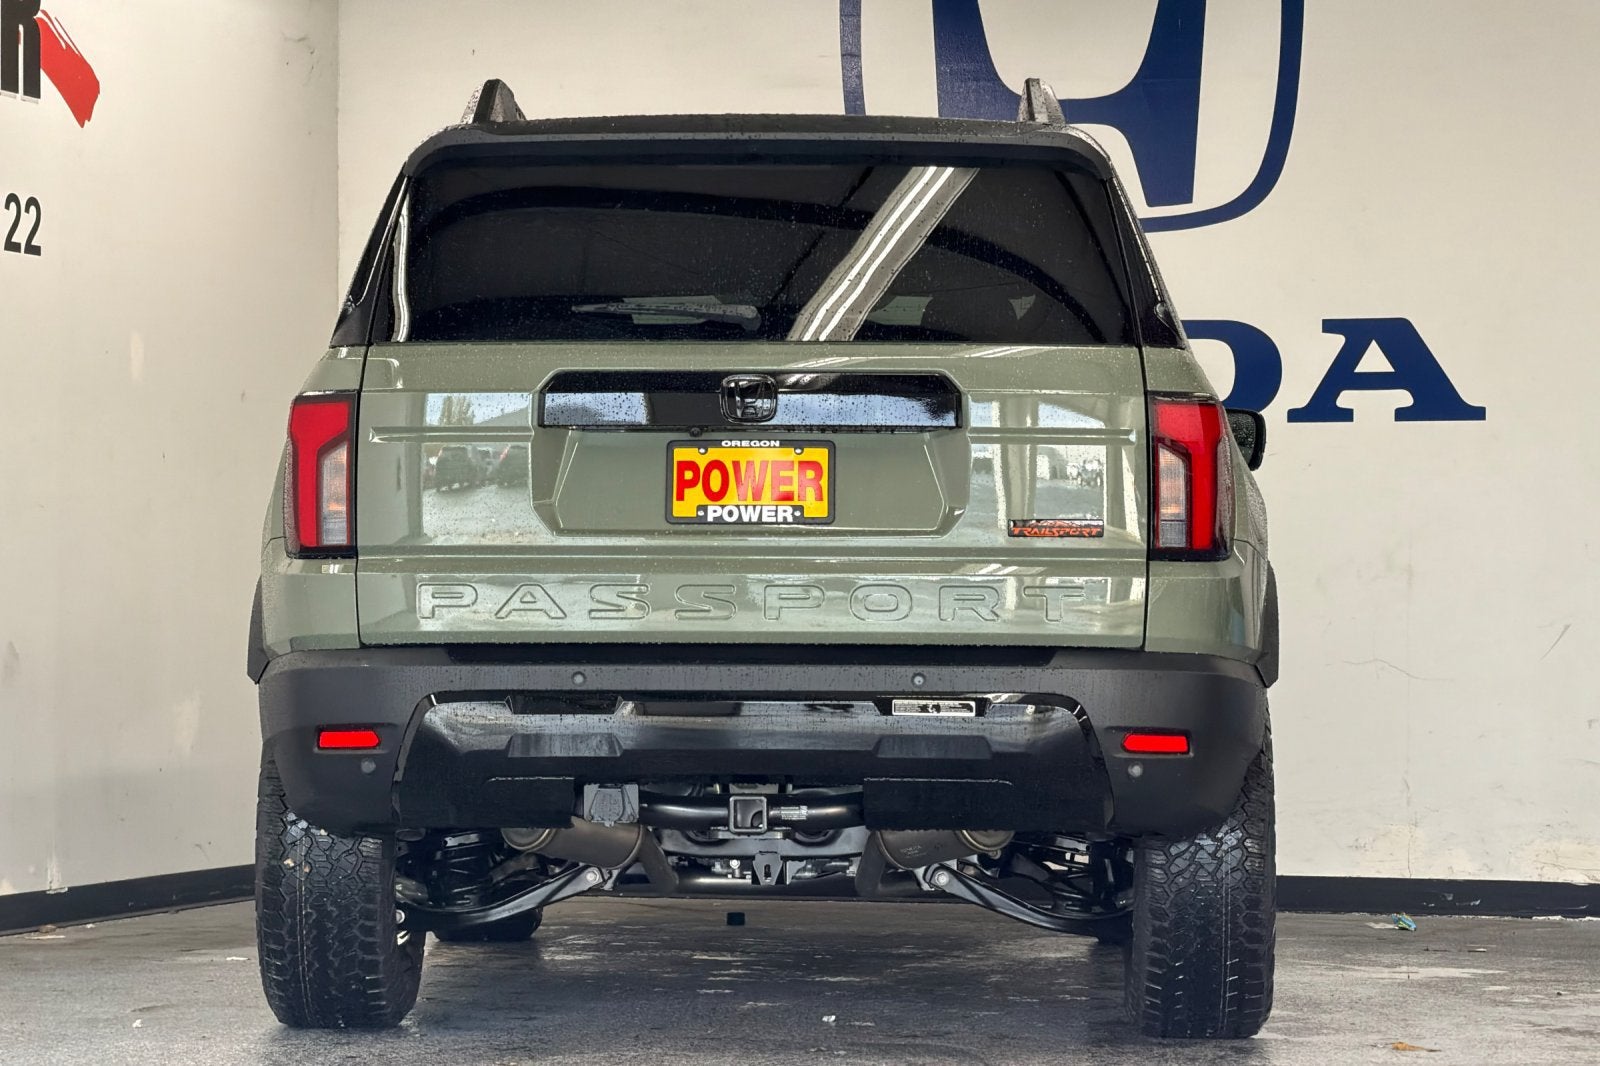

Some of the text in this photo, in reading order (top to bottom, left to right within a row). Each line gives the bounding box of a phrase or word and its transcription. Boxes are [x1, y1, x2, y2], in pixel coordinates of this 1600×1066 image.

[676, 459, 824, 502] POWER
[707, 505, 793, 522] POWER
[1011, 527, 1101, 537] TRAILSPORT
[417, 582, 1085, 620] PASSPORT
